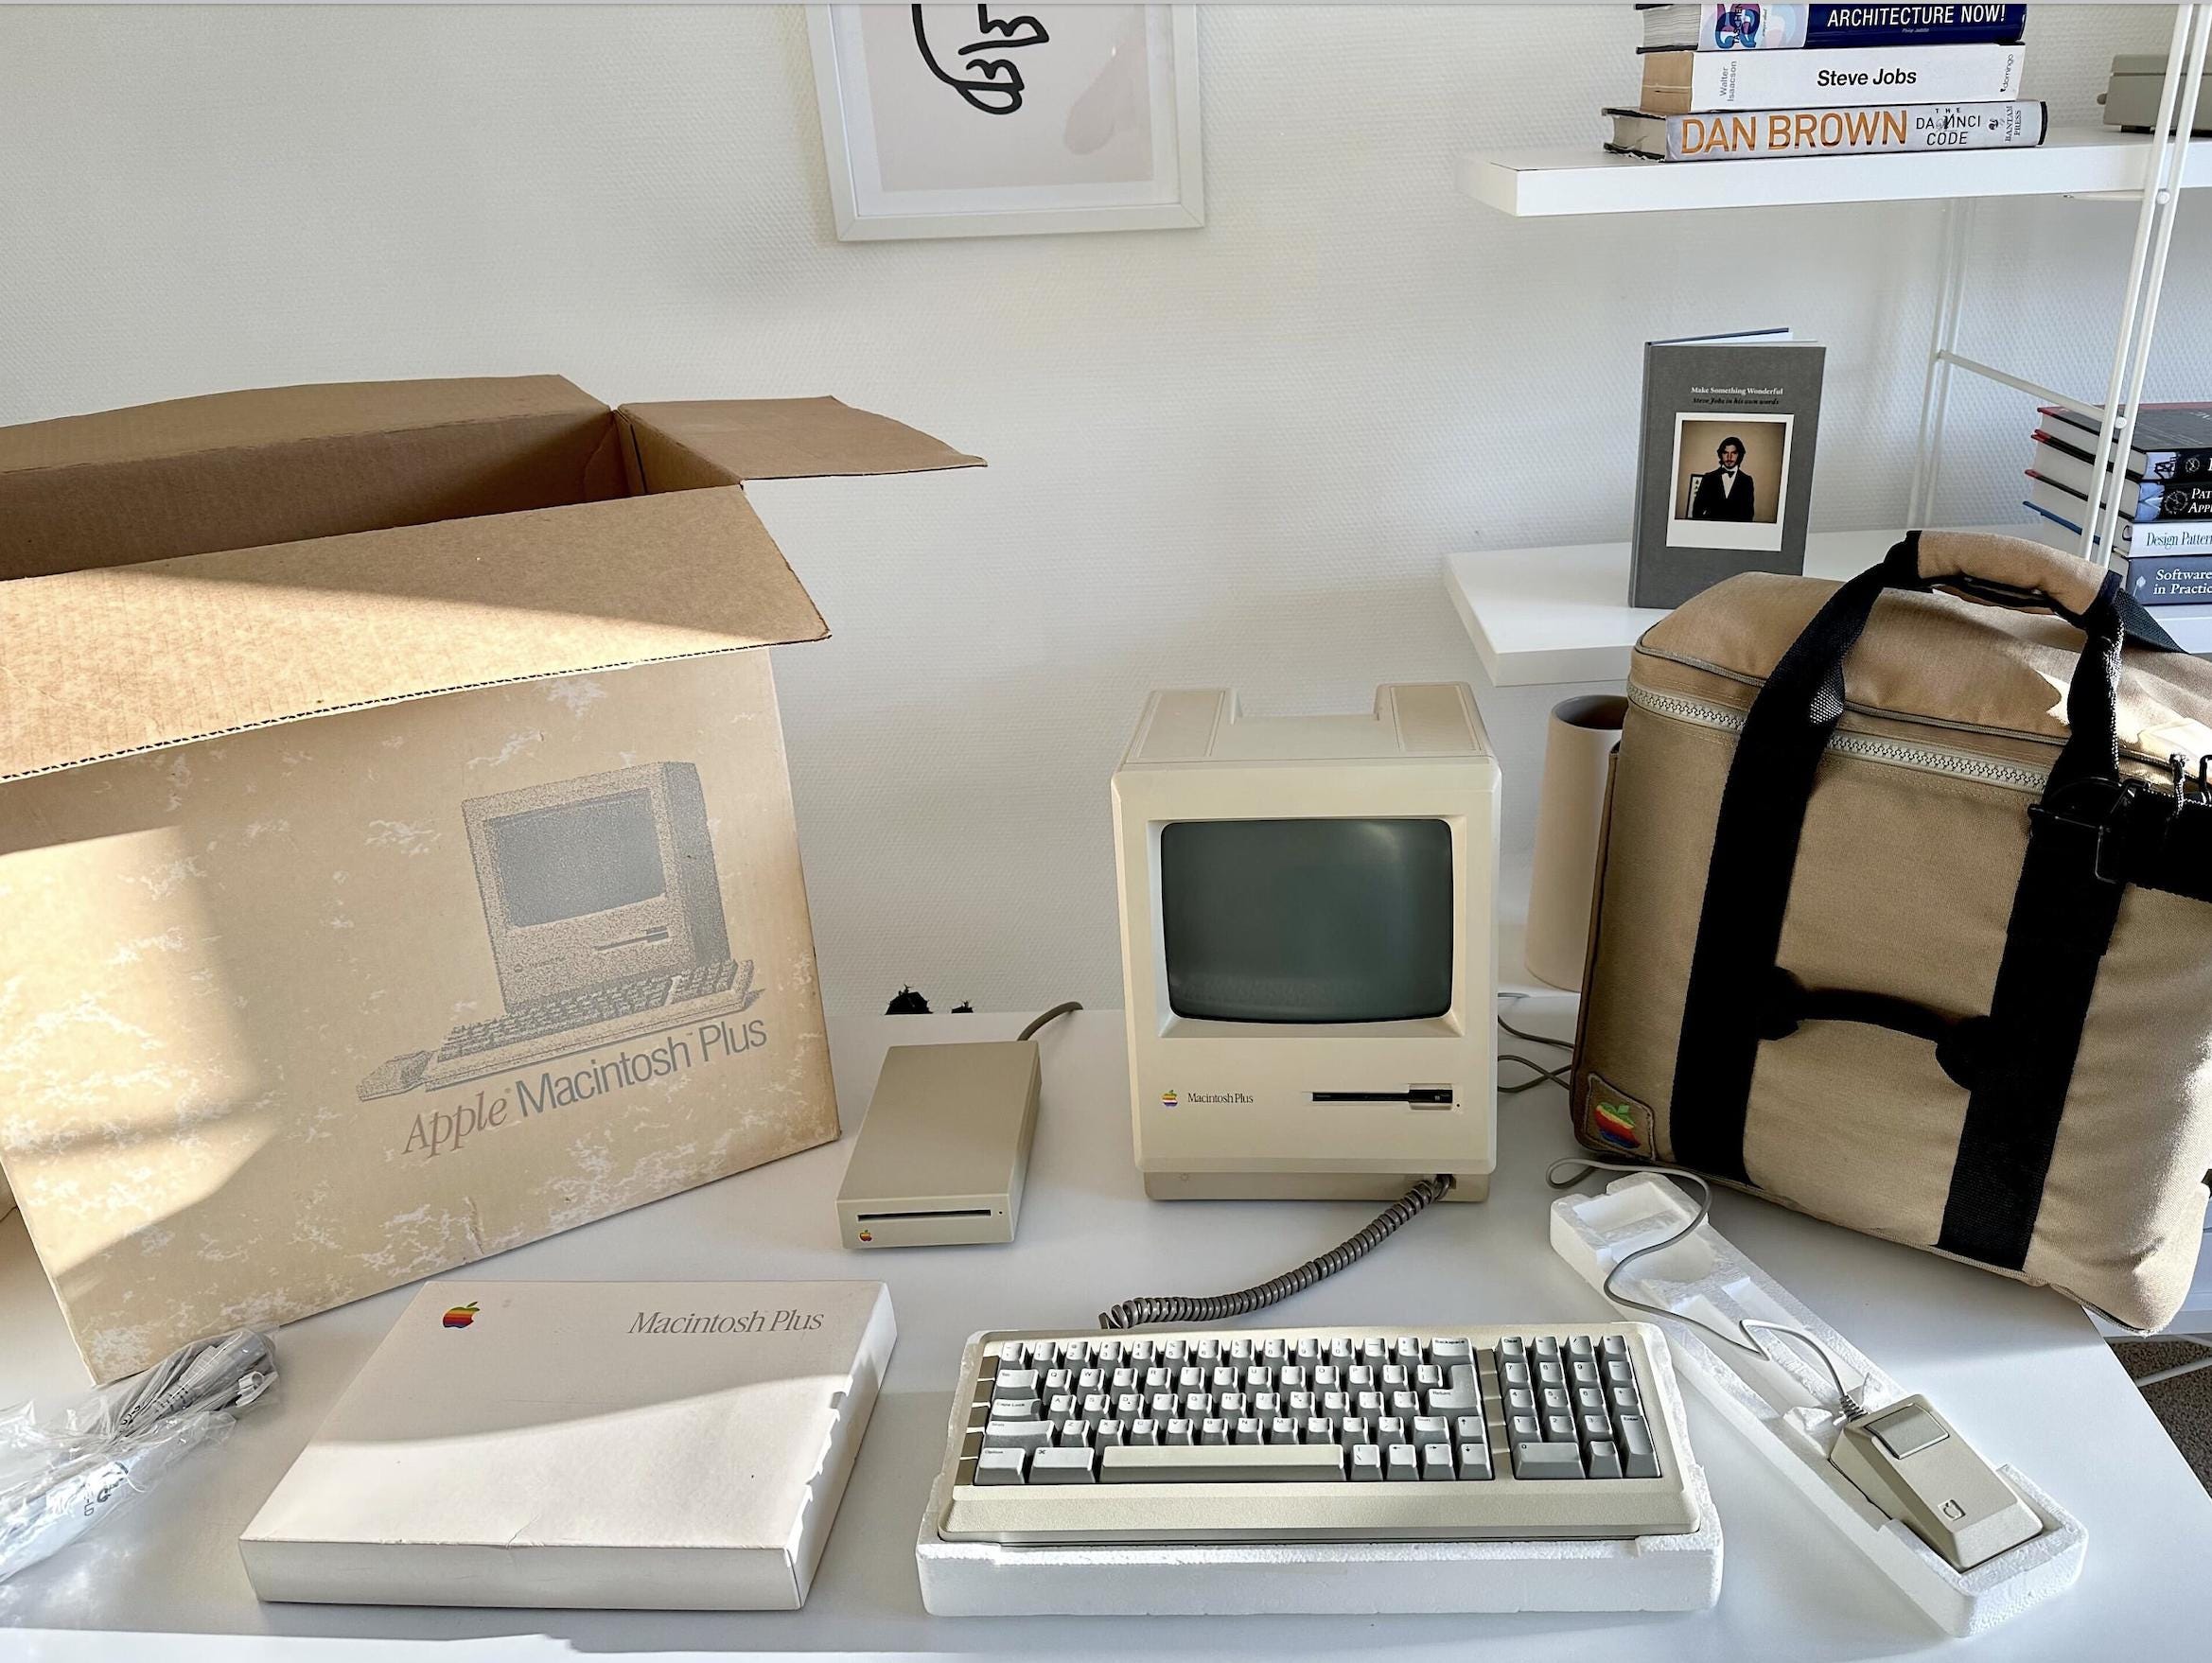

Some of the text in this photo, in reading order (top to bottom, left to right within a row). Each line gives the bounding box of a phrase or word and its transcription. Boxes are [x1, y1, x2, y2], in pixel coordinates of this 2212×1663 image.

[1827, 4, 2006, 27] ARCHITECTURE NOW!
[1719, 66, 1728, 96] Walter
[1727, 61, 1737, 102] Isaacson
[1817, 68, 1917, 86] Steve Jobs
[1679, 110, 1907, 153] DAN BROWN
[2005, 106, 2013, 142] BANTAM
[2013, 110, 2022, 136] PRESS
[1926, 131, 1969, 146] CODE
[1710, 387, 1747, 395] Something
[2147, 532, 2179, 550] Design
[2156, 569, 2212, 581] Software
[2153, 584, 2166, 595] in
[402, 1018, 768, 1159] Apple Macintosh Plus
[1187, 1093, 1254, 1104] Macintosh Plus
[628, 1308, 825, 1335] Macintosh Plus
